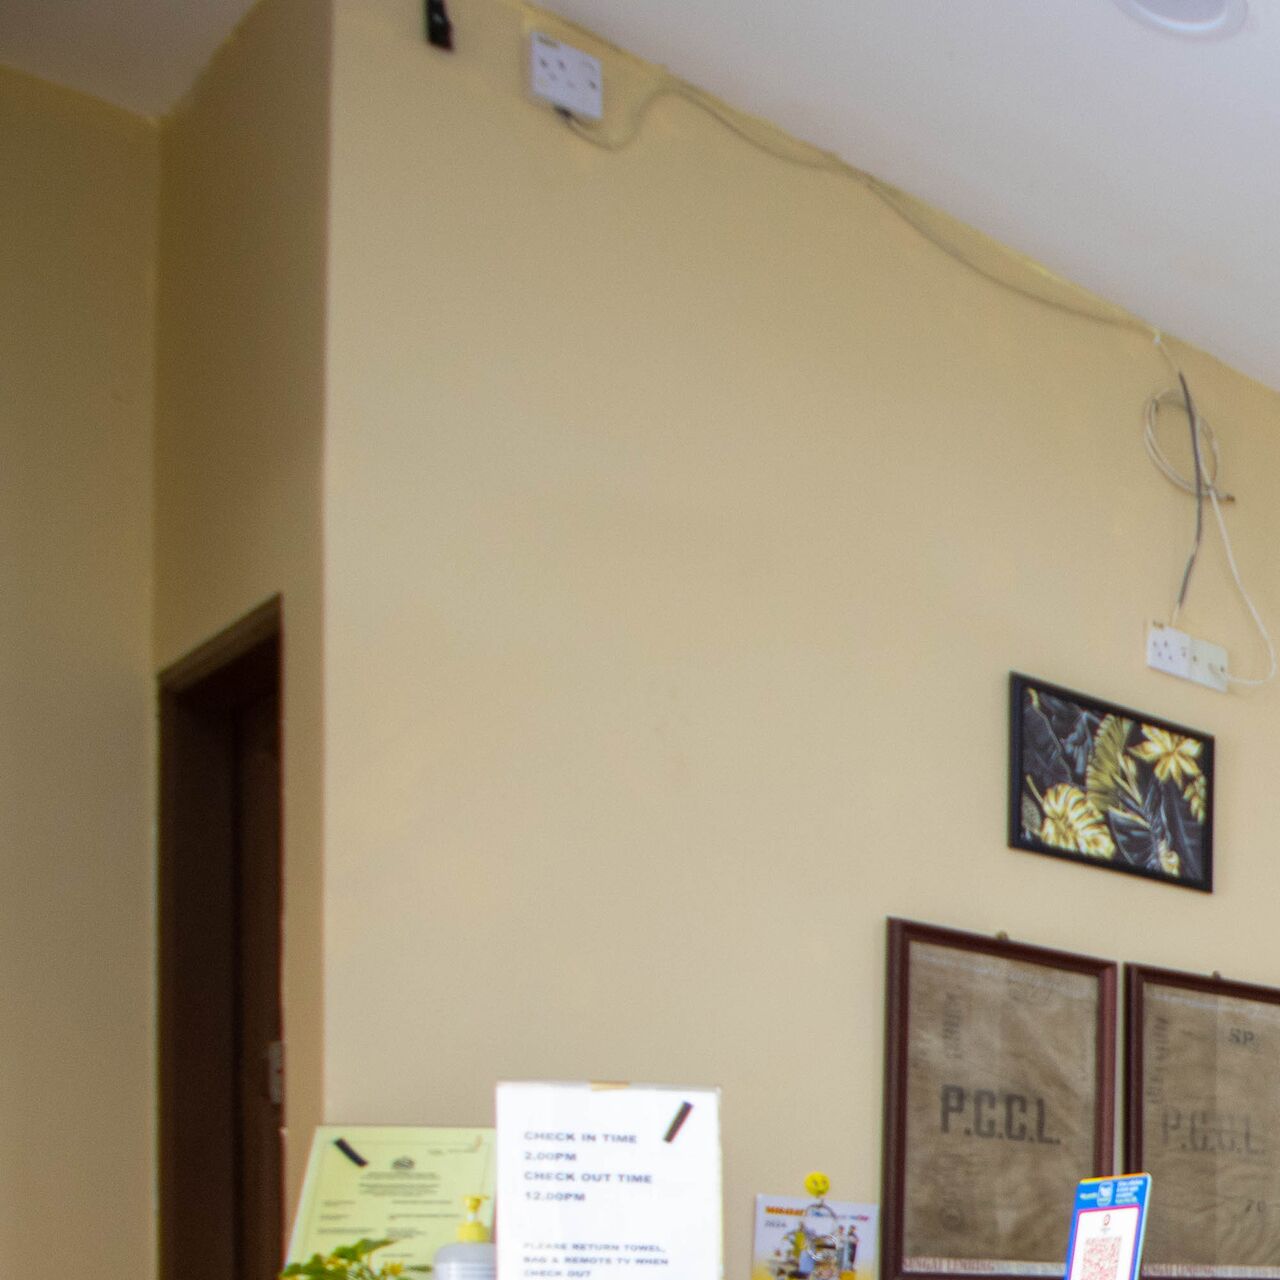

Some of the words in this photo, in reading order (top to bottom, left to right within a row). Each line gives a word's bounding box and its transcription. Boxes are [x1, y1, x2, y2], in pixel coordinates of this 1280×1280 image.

[524, 1131, 575, 1142] CHECK
[581, 1132, 597, 1142] IN
[603, 1133, 638, 1144] TIME
[524, 1151, 577, 1162] 2.00PM
[524, 1171, 575, 1182] CHECK
[581, 1172, 611, 1183] OUT
[618, 1173, 653, 1184] TIME
